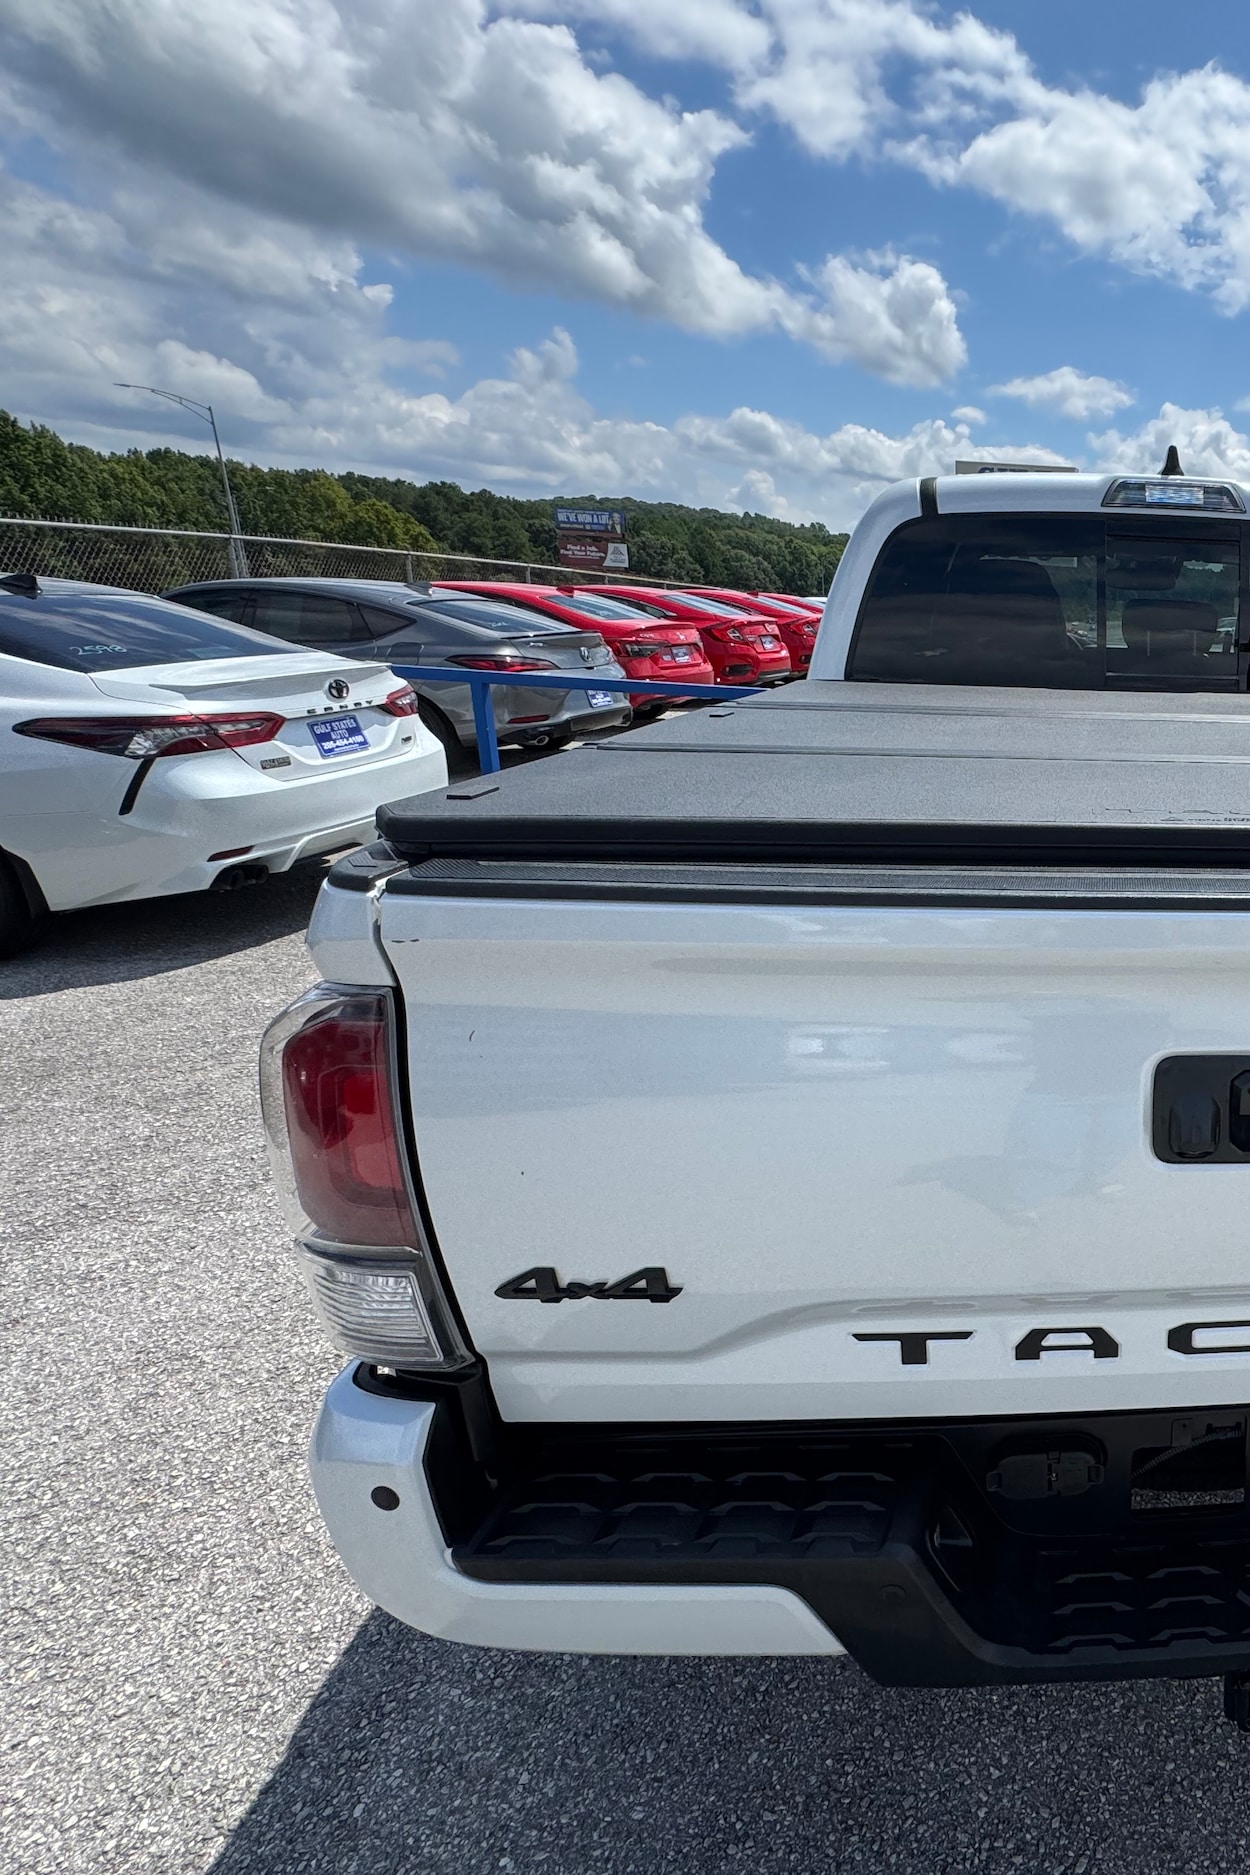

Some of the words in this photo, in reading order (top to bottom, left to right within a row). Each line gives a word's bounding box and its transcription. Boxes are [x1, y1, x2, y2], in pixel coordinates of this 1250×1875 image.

[557, 512, 577, 522] WE'VE
[577, 513, 592, 523] WON
[593, 514, 599, 523] A
[599, 515, 609, 524] LOT
[313, 722, 332, 735] GULF
[332, 718, 357, 731] STATES
[330, 729, 349, 739] AUTO
[494, 1267, 684, 1303] 4x4
